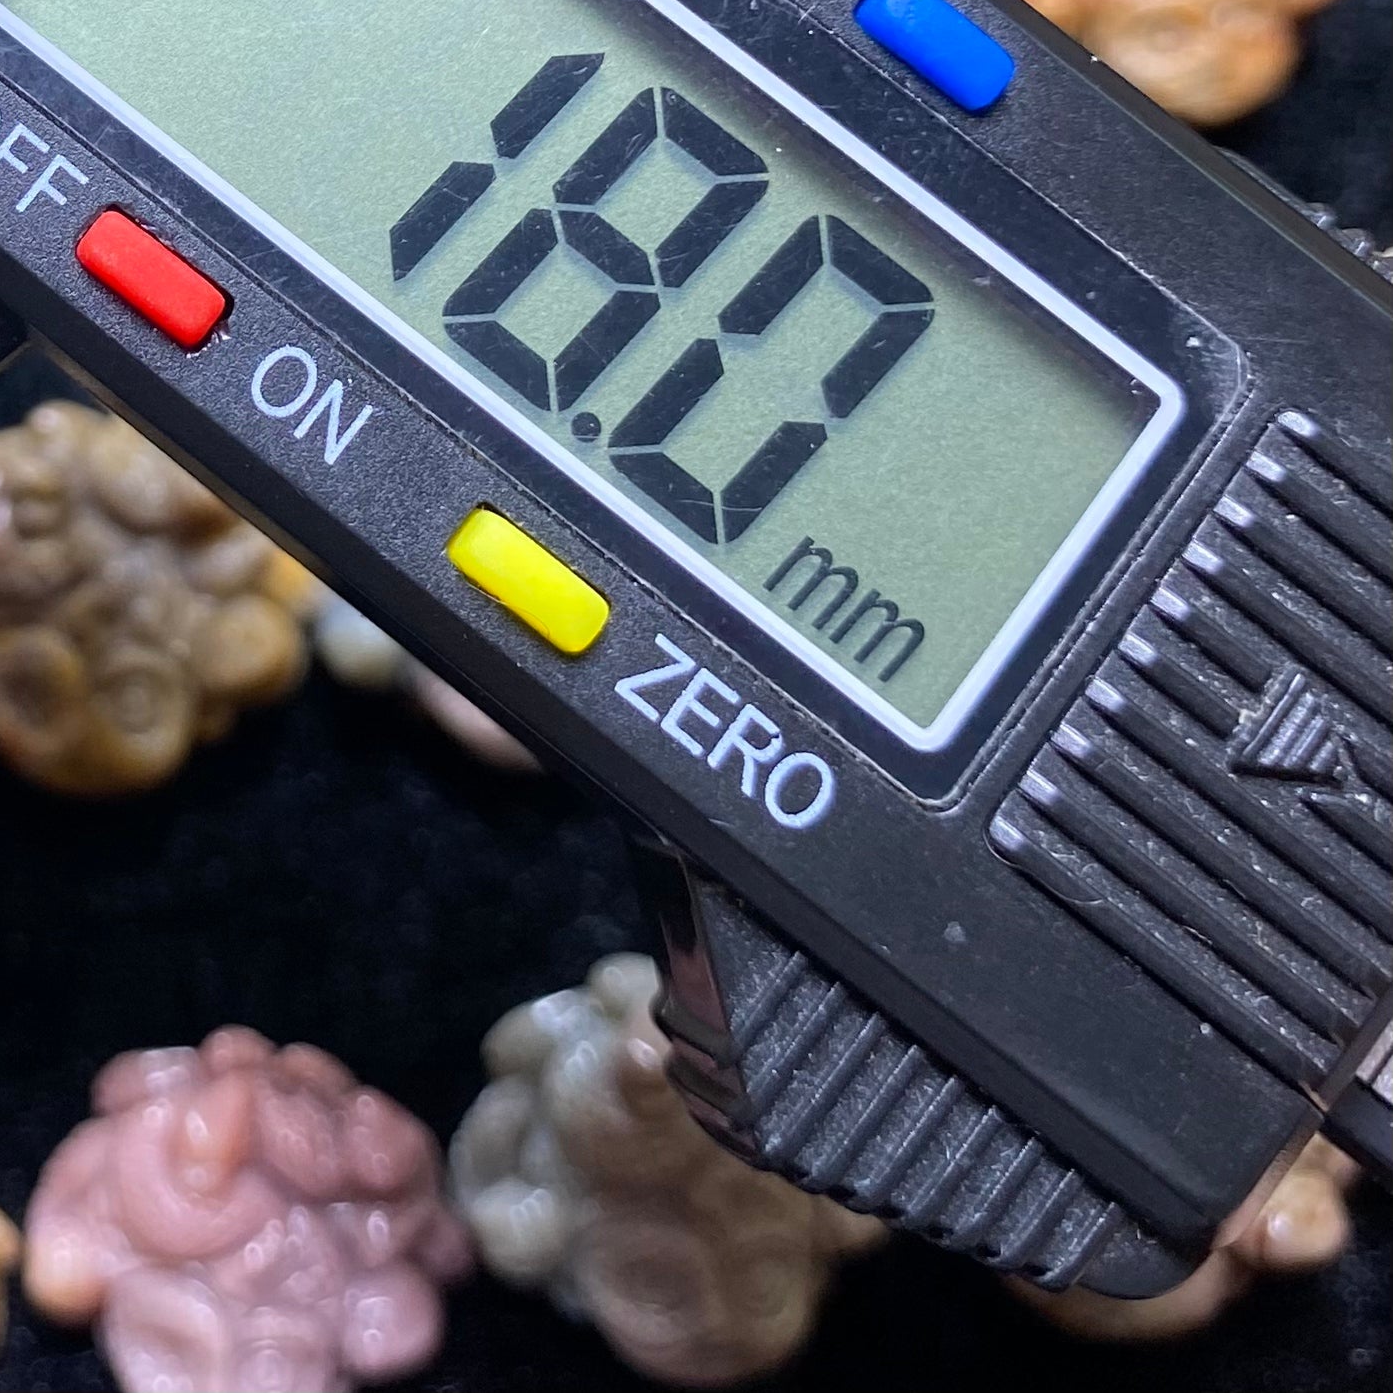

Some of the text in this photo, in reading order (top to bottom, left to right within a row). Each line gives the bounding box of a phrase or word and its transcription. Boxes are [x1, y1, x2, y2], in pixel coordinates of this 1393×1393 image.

[250, 344, 374, 466] ON
[389, 52, 936, 683] 18.0 mm
[614, 633, 836, 830] ZERO
